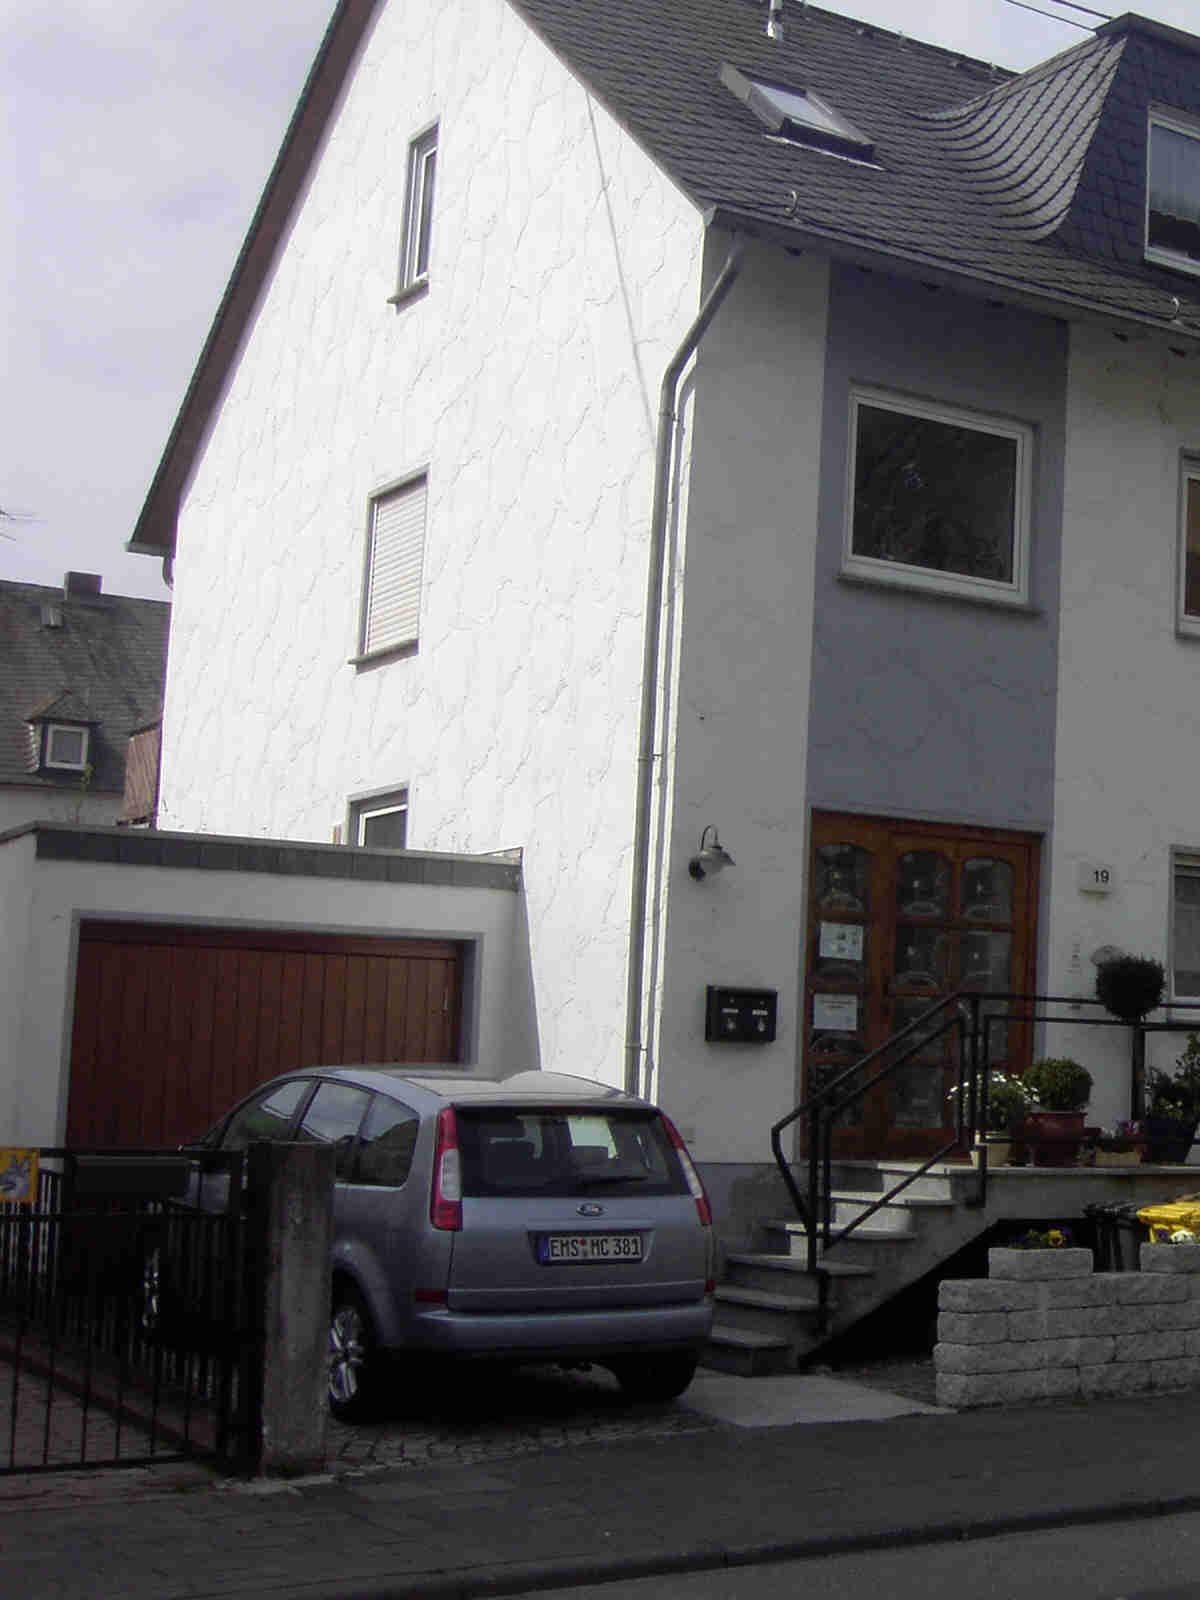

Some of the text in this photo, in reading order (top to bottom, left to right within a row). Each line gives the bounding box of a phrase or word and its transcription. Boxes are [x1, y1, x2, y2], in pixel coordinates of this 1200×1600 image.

[1093, 870, 1110, 883] 19
[550, 1238, 578, 1257] EMS
[614, 1237, 640, 1256] 381
